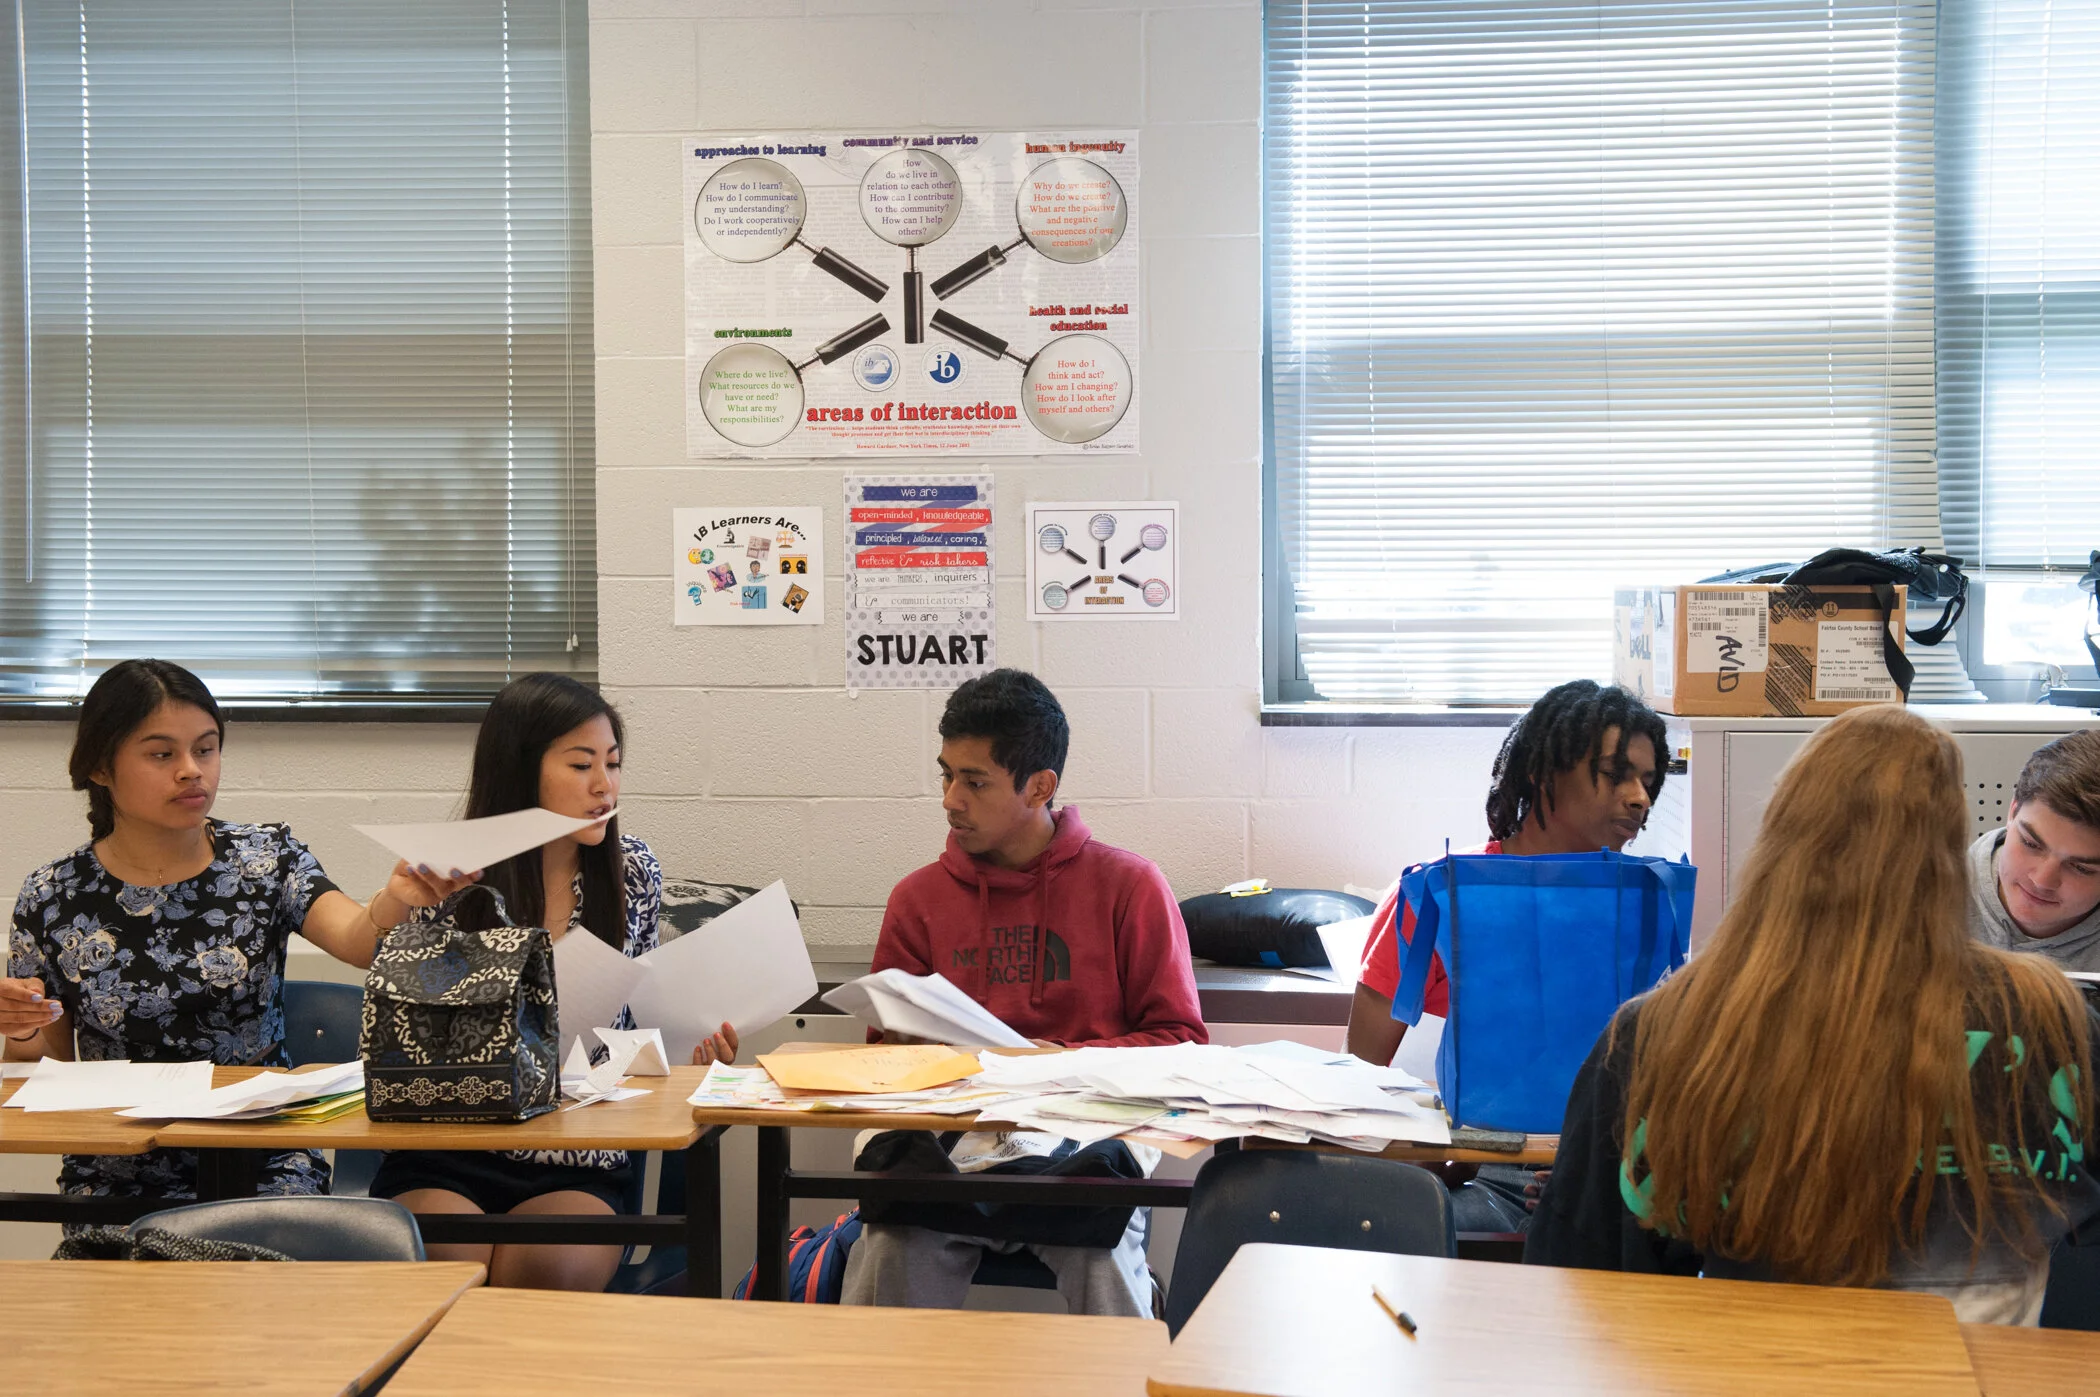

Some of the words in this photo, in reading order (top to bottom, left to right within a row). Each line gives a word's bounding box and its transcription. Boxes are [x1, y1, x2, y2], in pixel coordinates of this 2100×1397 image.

[843, 136, 909, 148] community
[912, 136, 934, 146] and
[936, 134, 979, 146] service
[694, 145, 760, 159] approaches
[763, 145, 774, 155] to
[777, 144, 827, 157] learning
[1025, 142, 1066, 154] human
[1069, 141, 1126, 154] ingenuity
[886, 171, 896, 179] do
[912, 170, 928, 178] live
[930, 170, 938, 178] in
[759, 182, 783, 190] learn?
[911, 182, 929, 190] each
[931, 181, 957, 189] other?
[1034, 182, 1052, 191] Why
[1055, 182, 1066, 190] do
[1082, 181, 1111, 189] create?
[870, 194, 889, 202] How
[907, 193, 912, 201] I
[914, 193, 954, 201] contribute
[1034, 194, 1052, 202] How
[1055, 193, 1066, 201] do
[1082, 192, 1111, 200] create?
[728, 204, 789, 214] understanding?
[885, 205, 898, 213] the
[900, 204, 949, 214] community?
[1030, 205, 1051, 213] What
[704, 217, 716, 225] Do
[746, 217, 801, 225] cooperatively
[882, 216, 901, 224] How
[925, 216, 943, 225] help
[1046, 216, 1061, 224] and
[1063, 217, 1098, 225] negative
[727, 227, 788, 237] independently?
[898, 227, 927, 236] others?
[1031, 228, 1086, 237] consequences
[1089, 227, 1098, 235] of
[1052, 238, 1093, 247] creations?
[1029, 305, 1066, 316] health
[1069, 304, 1092, 315] and
[1095, 304, 1129, 315] social
[1050, 320, 1108, 331] education
[714, 327, 793, 338] environments
[1057, 360, 1076, 368] How
[1079, 360, 1089, 368] do
[715, 371, 741, 379] Where
[768, 370, 788, 378] live?
[1048, 371, 1069, 380] think
[1071, 371, 1086, 379] and
[1088, 371, 1105, 379] act?
[709, 382, 730, 390] What
[1035, 383, 1054, 391] How
[1077, 382, 1118, 392] changing?
[725, 393, 744, 401] have
[1037, 395, 1056, 403] How
[1077, 394, 1095, 402] look
[1097, 393, 1117, 401] after
[806, 408, 864, 422] areas
[870, 402, 894, 421] of
[898, 401, 1018, 421] interaction
[1038, 406, 1066, 415] myself
[1068, 405, 1083, 413] and
[1085, 404, 1114, 413] others?
[720, 415, 784, 425] responsibilities?
[900, 488, 916, 497] we
[919, 488, 938, 497] are
[693, 526, 709, 542] IB
[711, 516, 772, 532] Learners
[775, 517, 807, 541] Are...
[861, 555, 895, 565] reflective
[891, 596, 969, 605] communicators!
[902, 613, 917, 621] we
[920, 613, 938, 621] are
[857, 634, 988, 666] STUART
[1715, 635, 1746, 694] AVID
[991, 925, 1032, 946] THE
[986, 964, 1031, 986] ACE
